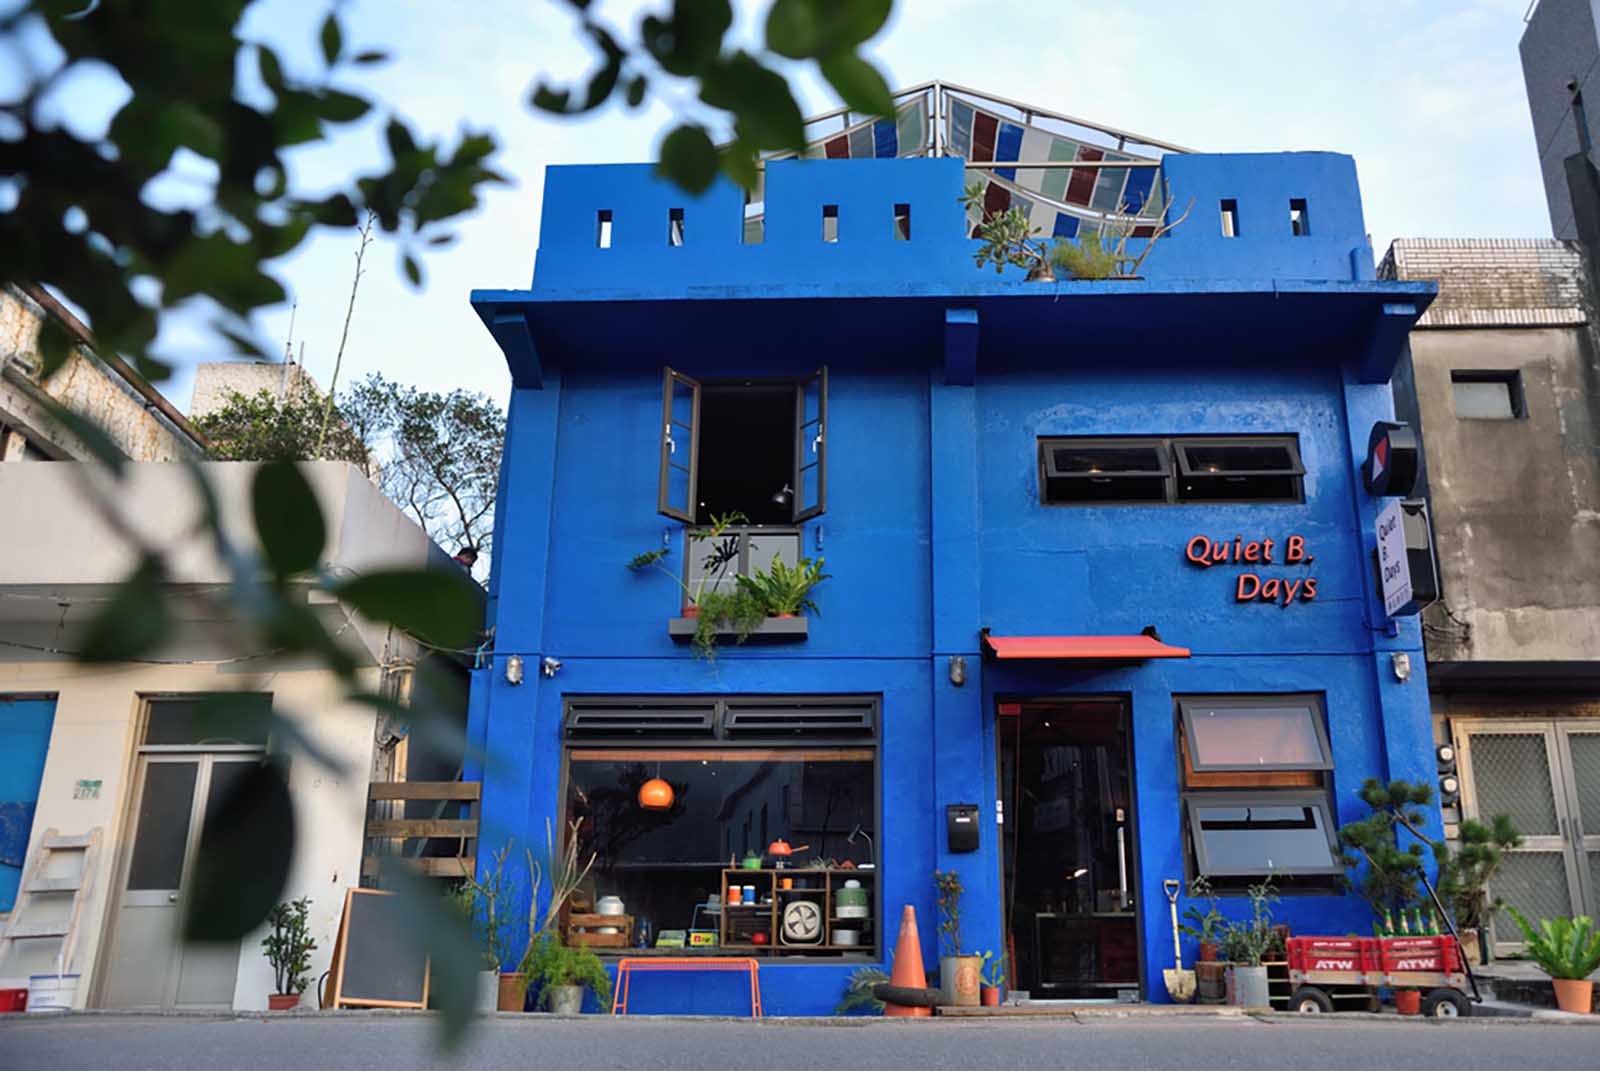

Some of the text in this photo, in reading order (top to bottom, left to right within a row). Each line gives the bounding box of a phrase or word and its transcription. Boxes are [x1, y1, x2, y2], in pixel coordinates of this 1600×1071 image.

[1185, 534, 1315, 566] Quiet B.
[1236, 573, 1318, 606] Days
[1315, 960, 1353, 970] ATW
[1396, 959, 1436, 969] ATW
